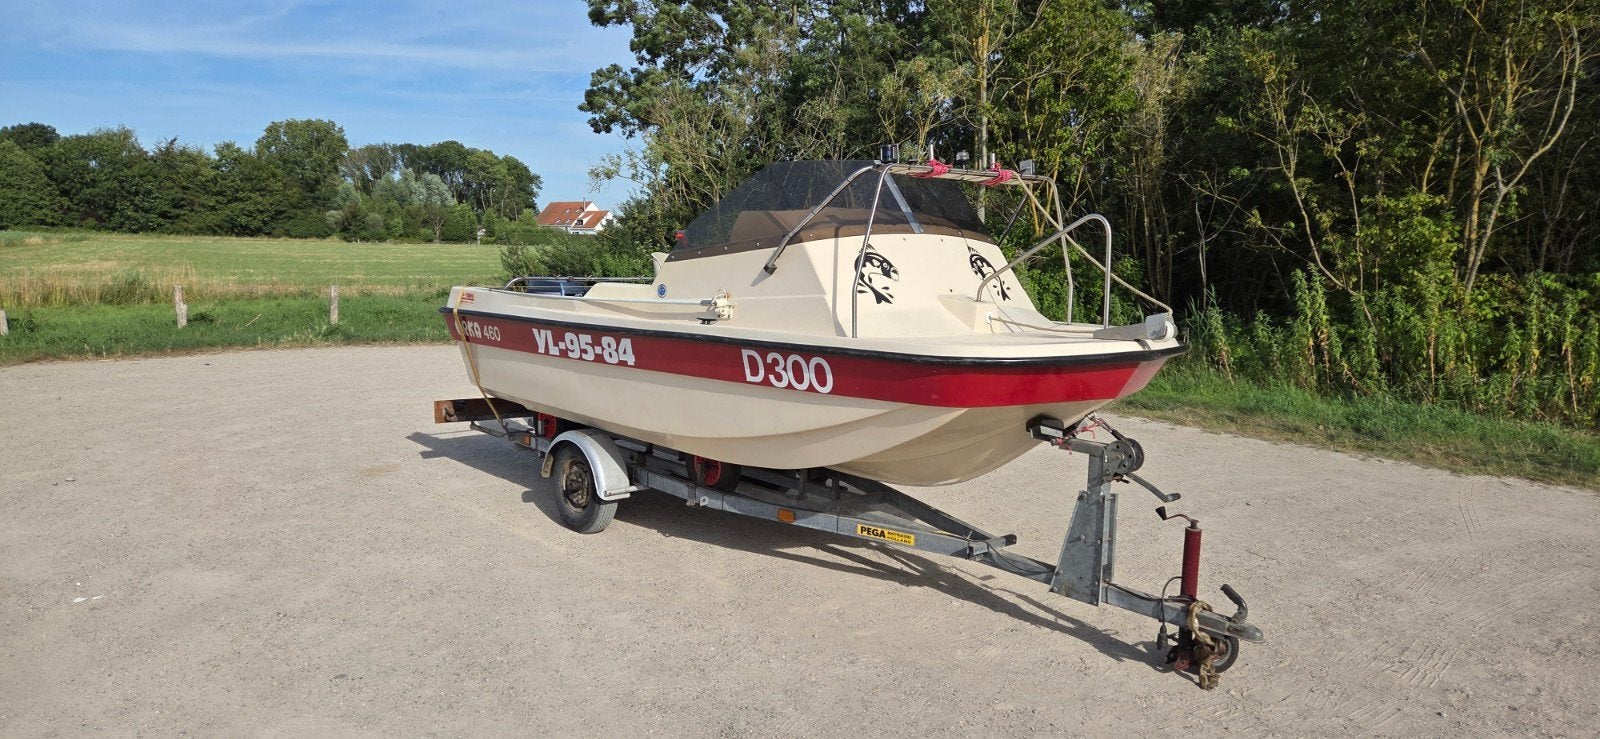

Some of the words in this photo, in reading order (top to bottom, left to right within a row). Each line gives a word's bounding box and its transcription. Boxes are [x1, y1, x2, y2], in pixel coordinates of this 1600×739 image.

[483, 325, 501, 341] 460
[532, 328, 636, 366] YL-95-84
[860, 526, 886, 539] PEGA
